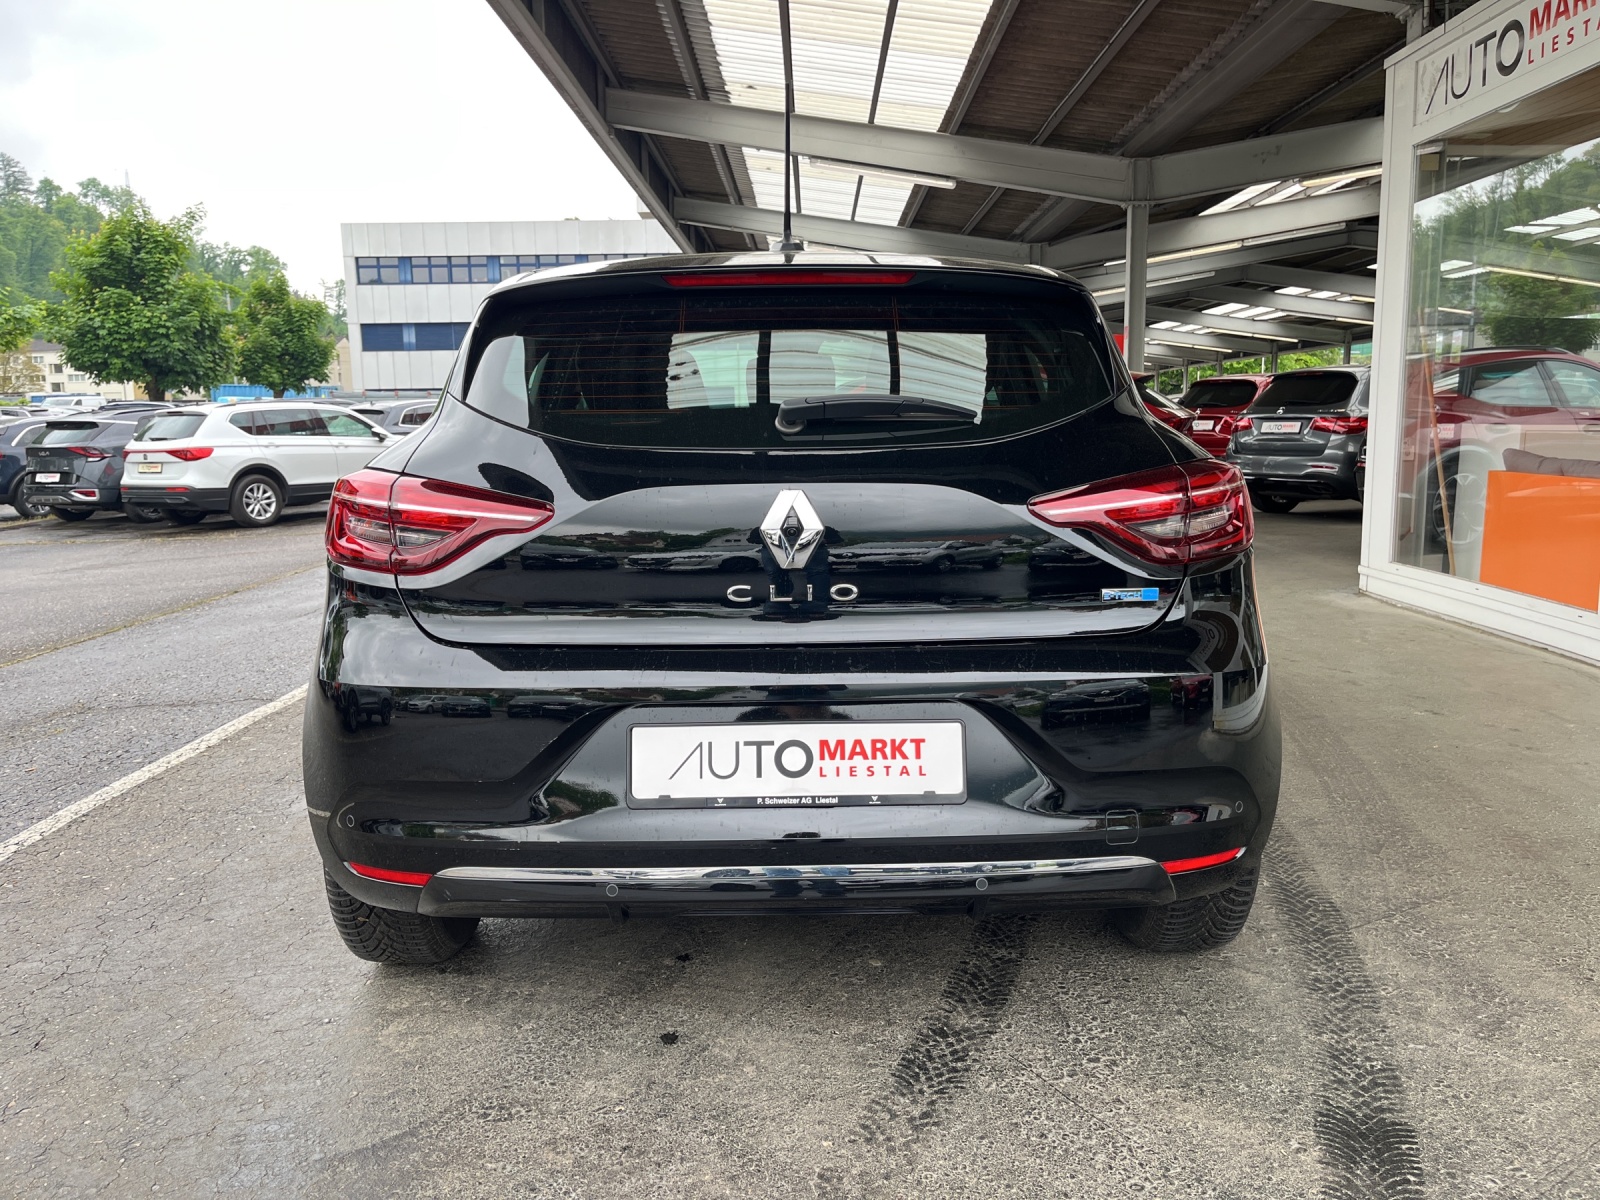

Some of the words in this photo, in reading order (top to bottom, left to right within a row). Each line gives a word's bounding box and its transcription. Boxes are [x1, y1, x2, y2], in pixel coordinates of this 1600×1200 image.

[1425, 19, 1525, 115] AUTO
[1529, 0, 1600, 40] MA
[727, 584, 859, 602] CLIO
[668, 739, 814, 780] AUTO
[819, 738, 926, 761] MARKT
[819, 765, 927, 777] LIESTAL
[765, 797, 800, 805] Schweizer
[815, 796, 838, 804] Liestal
